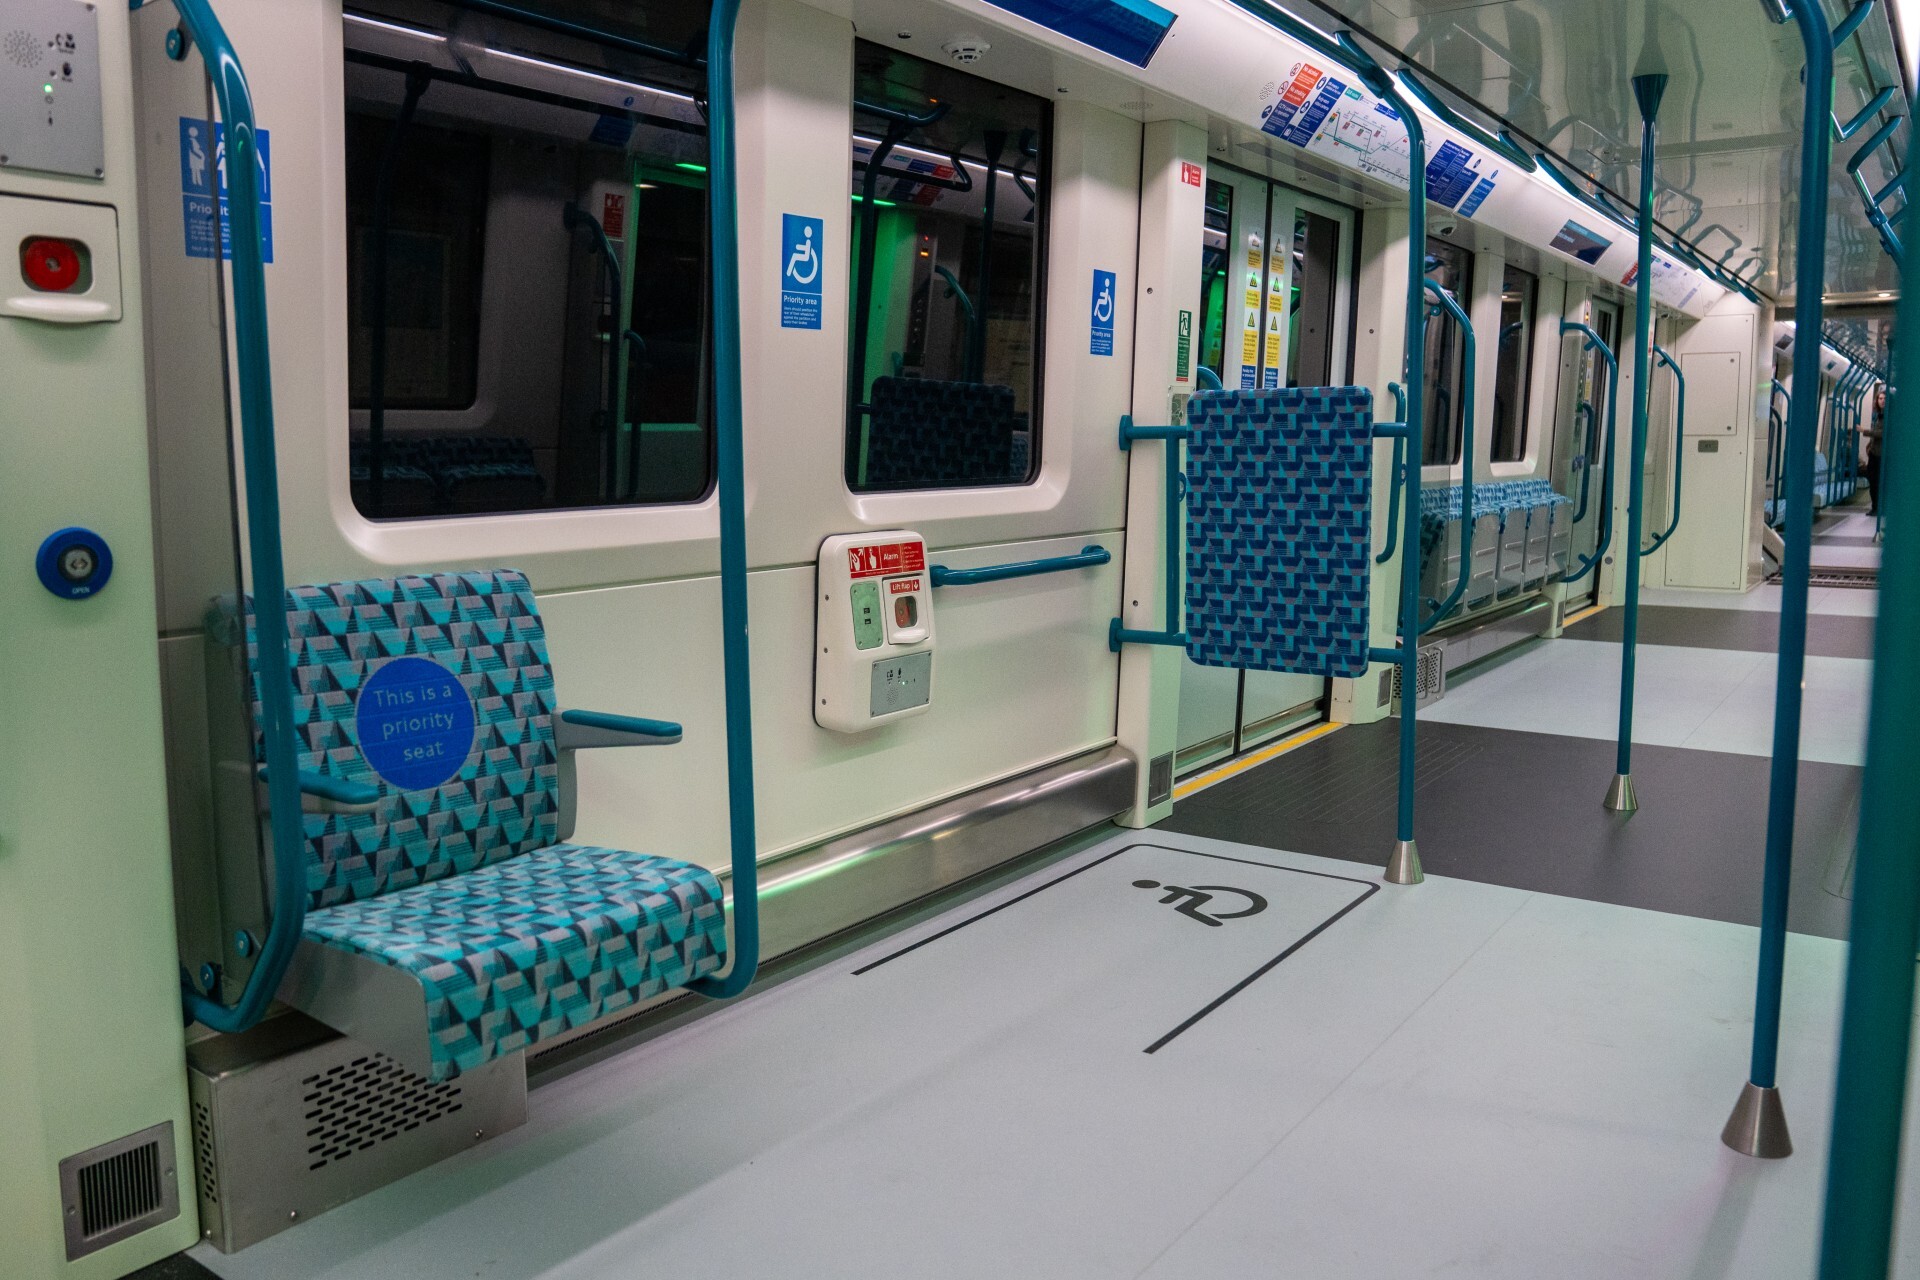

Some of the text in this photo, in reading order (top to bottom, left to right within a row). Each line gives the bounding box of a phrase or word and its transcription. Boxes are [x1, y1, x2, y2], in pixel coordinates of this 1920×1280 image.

[783, 295, 804, 305] Priority
[1092, 330, 1103, 338] Priority
[71, 586, 90, 594] OPEN
[902, 583, 911, 591] flap
[373, 685, 452, 708] This is a
[382, 712, 454, 740] priority
[403, 741, 444, 761] seat
